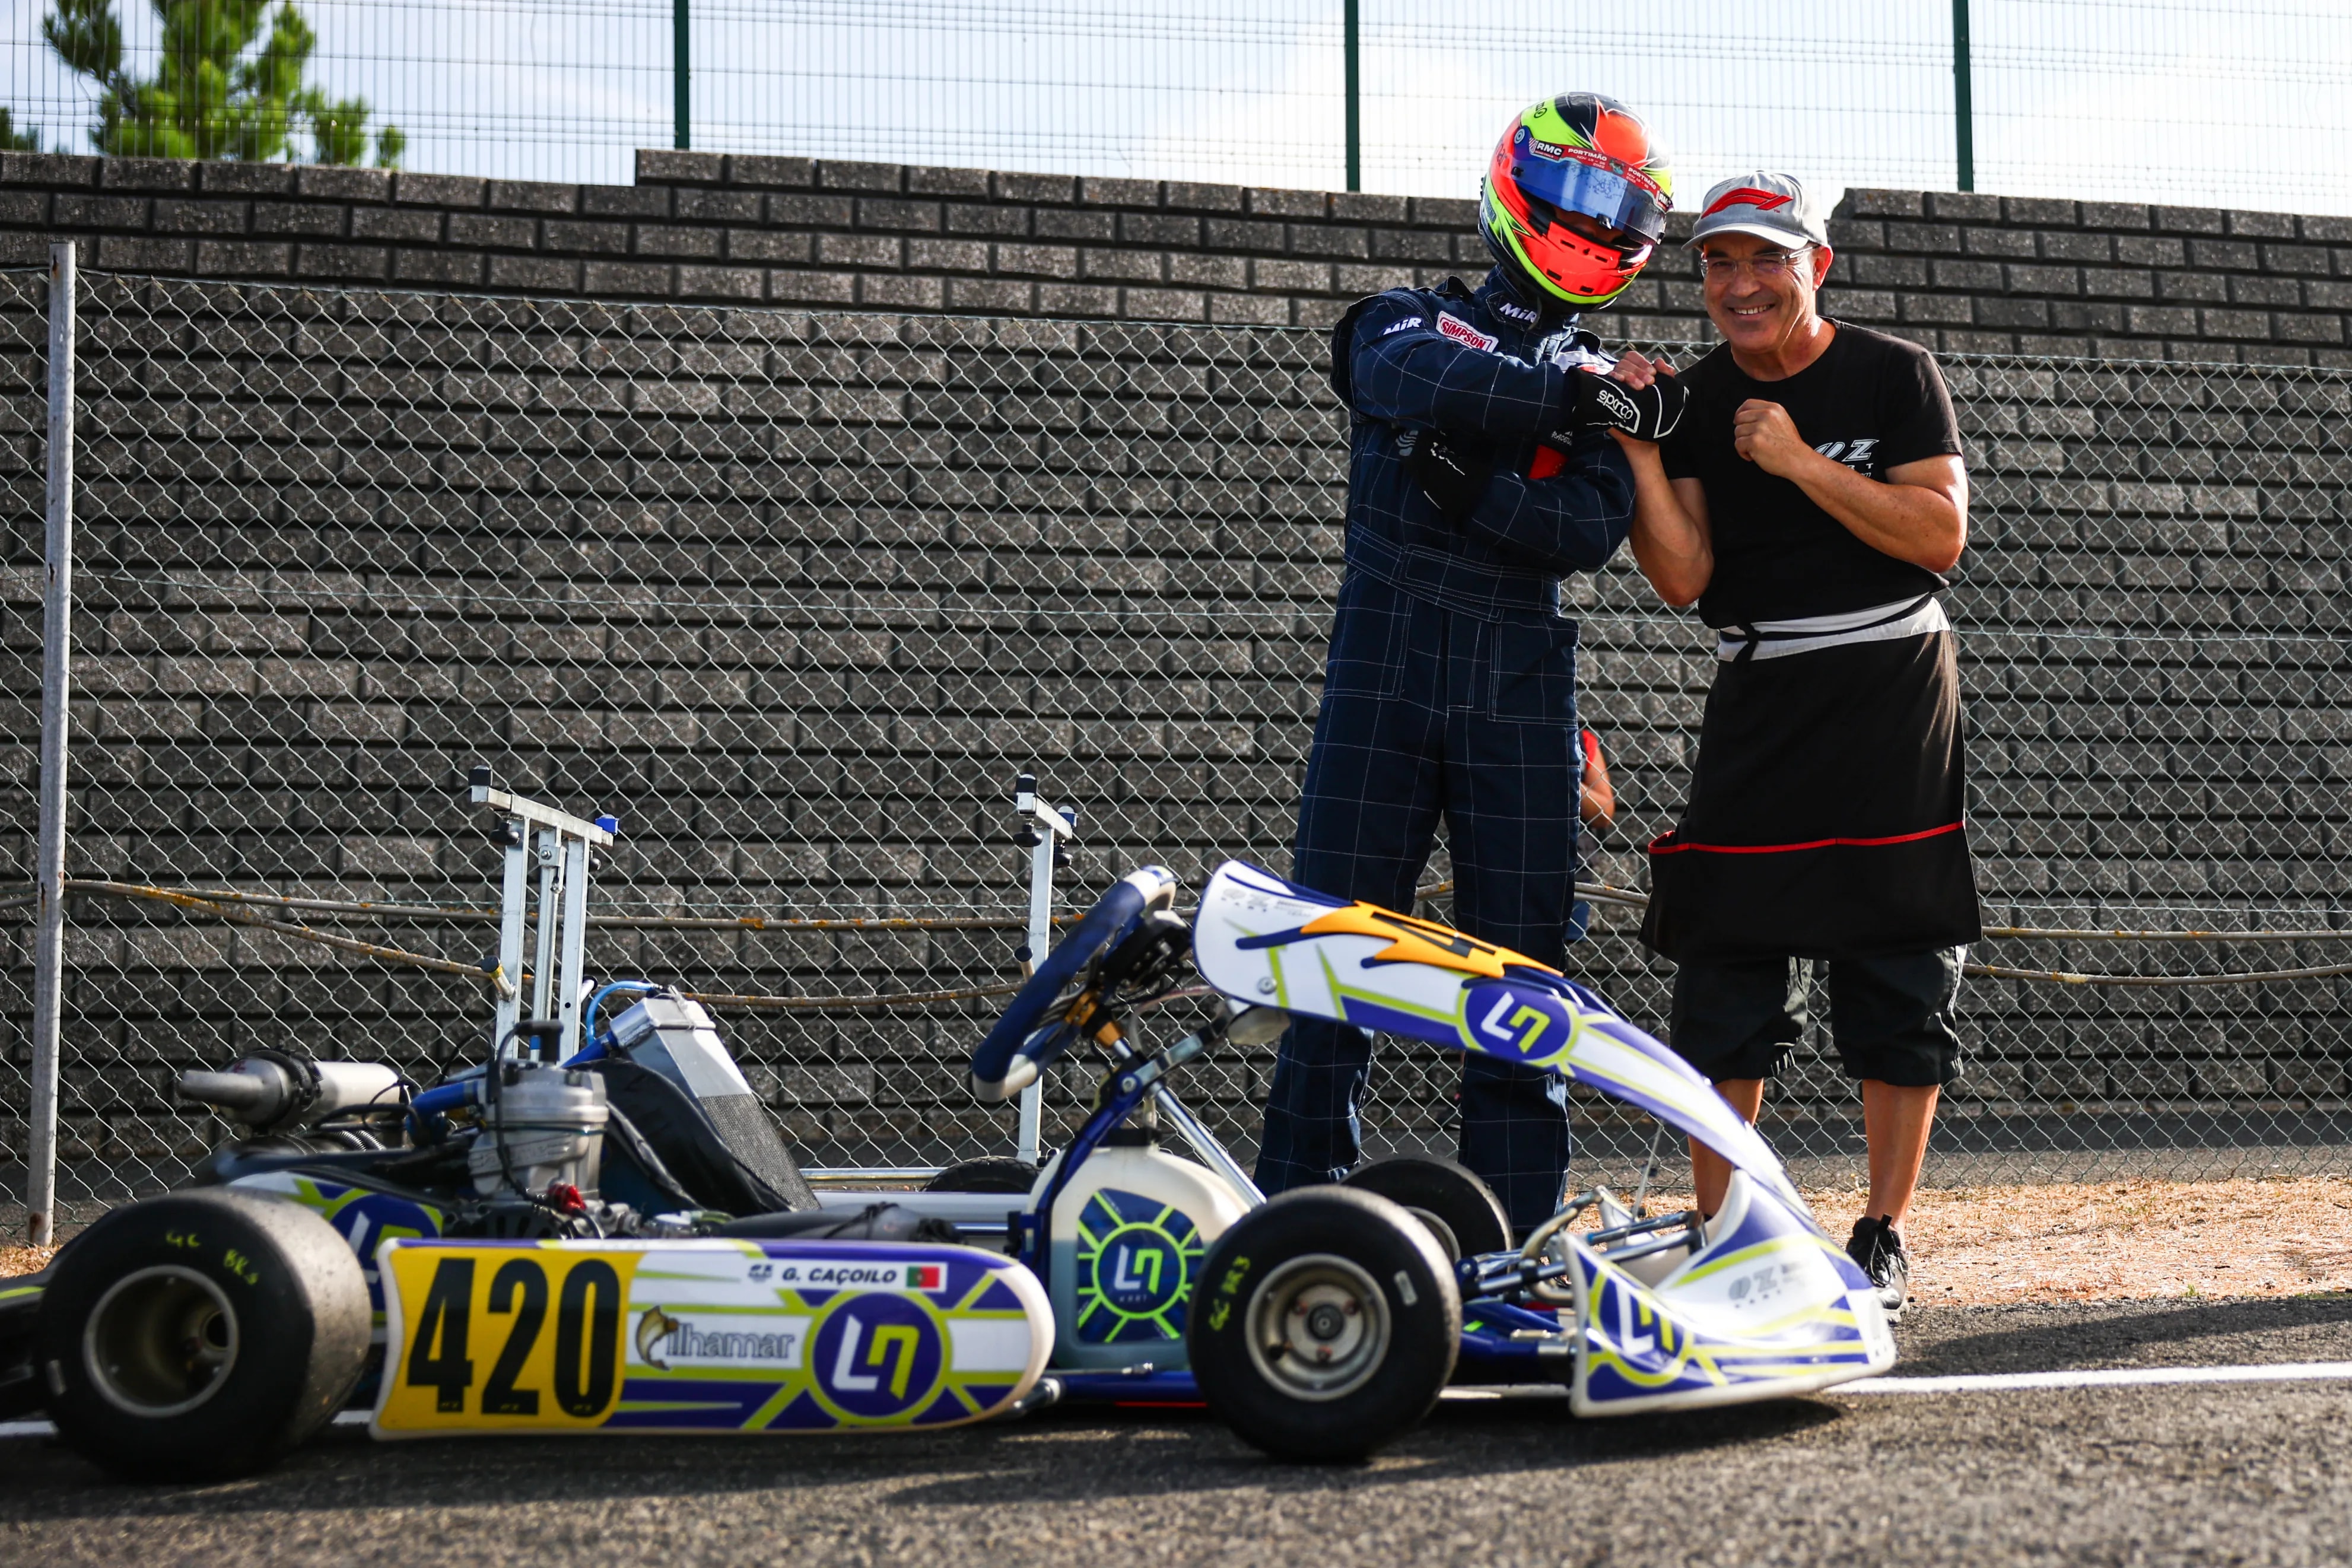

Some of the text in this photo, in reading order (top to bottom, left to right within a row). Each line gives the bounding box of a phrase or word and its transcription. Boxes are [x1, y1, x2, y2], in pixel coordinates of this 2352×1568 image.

[1536, 142, 1563, 157] RMC
[1568, 148, 1608, 162] PORTIMÃO
[1628, 167, 1657, 190] PORTIMÃO
[1441, 320, 1487, 349] SIMPSON
[1598, 389, 1633, 420] sparco
[782, 1268, 801, 1281] G.
[808, 1268, 897, 1286] CAÇOILO
[406, 1257, 621, 1419] 420
